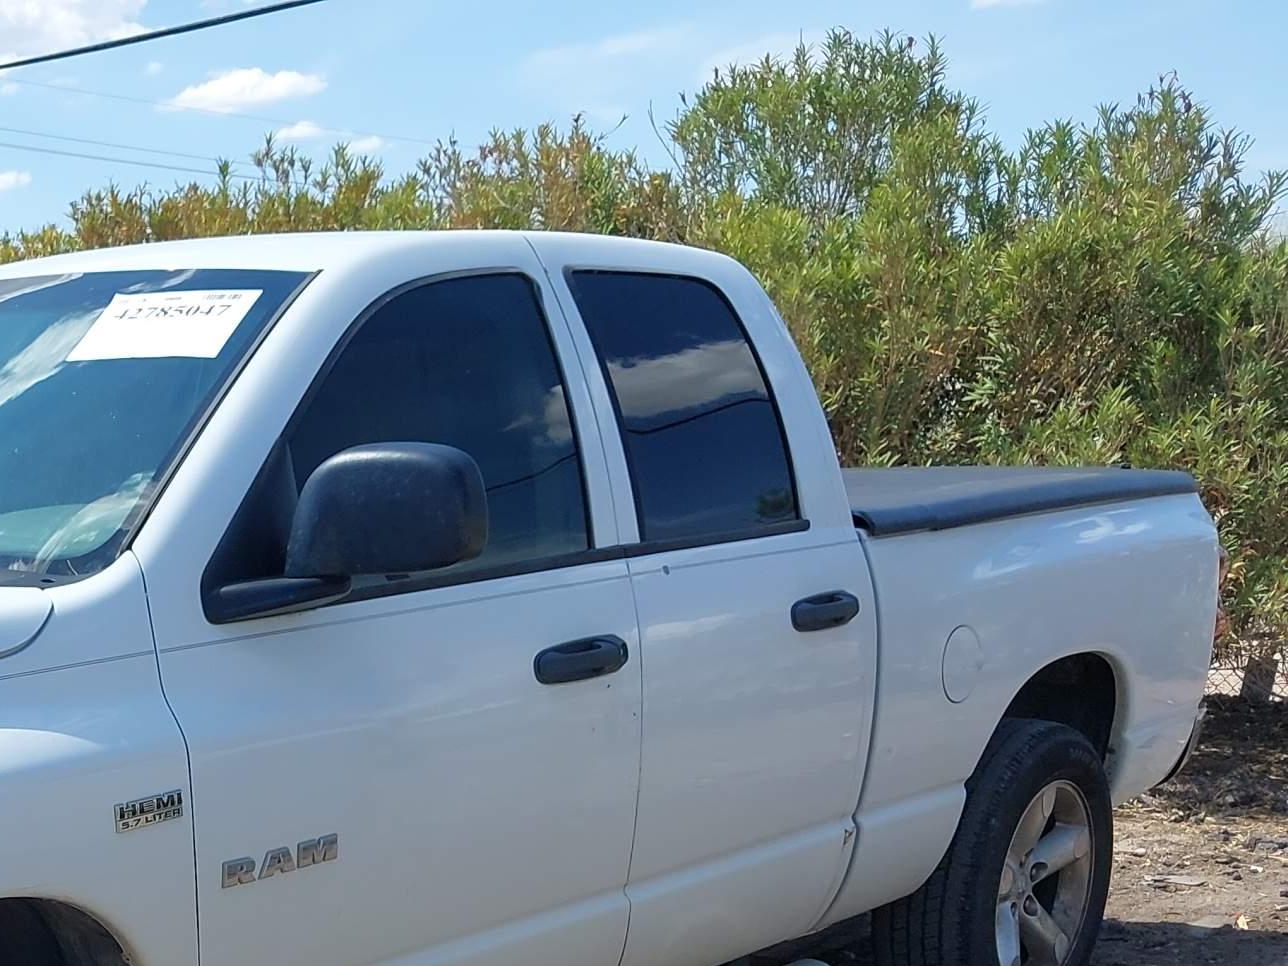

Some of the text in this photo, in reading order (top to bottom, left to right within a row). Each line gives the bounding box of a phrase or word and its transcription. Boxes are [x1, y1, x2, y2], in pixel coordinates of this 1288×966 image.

[114, 304, 232, 320] 42785047
[119, 792, 183, 819] HEMI
[121, 807, 181, 830] 5.7 LITER
[221, 832, 338, 889] RAM
